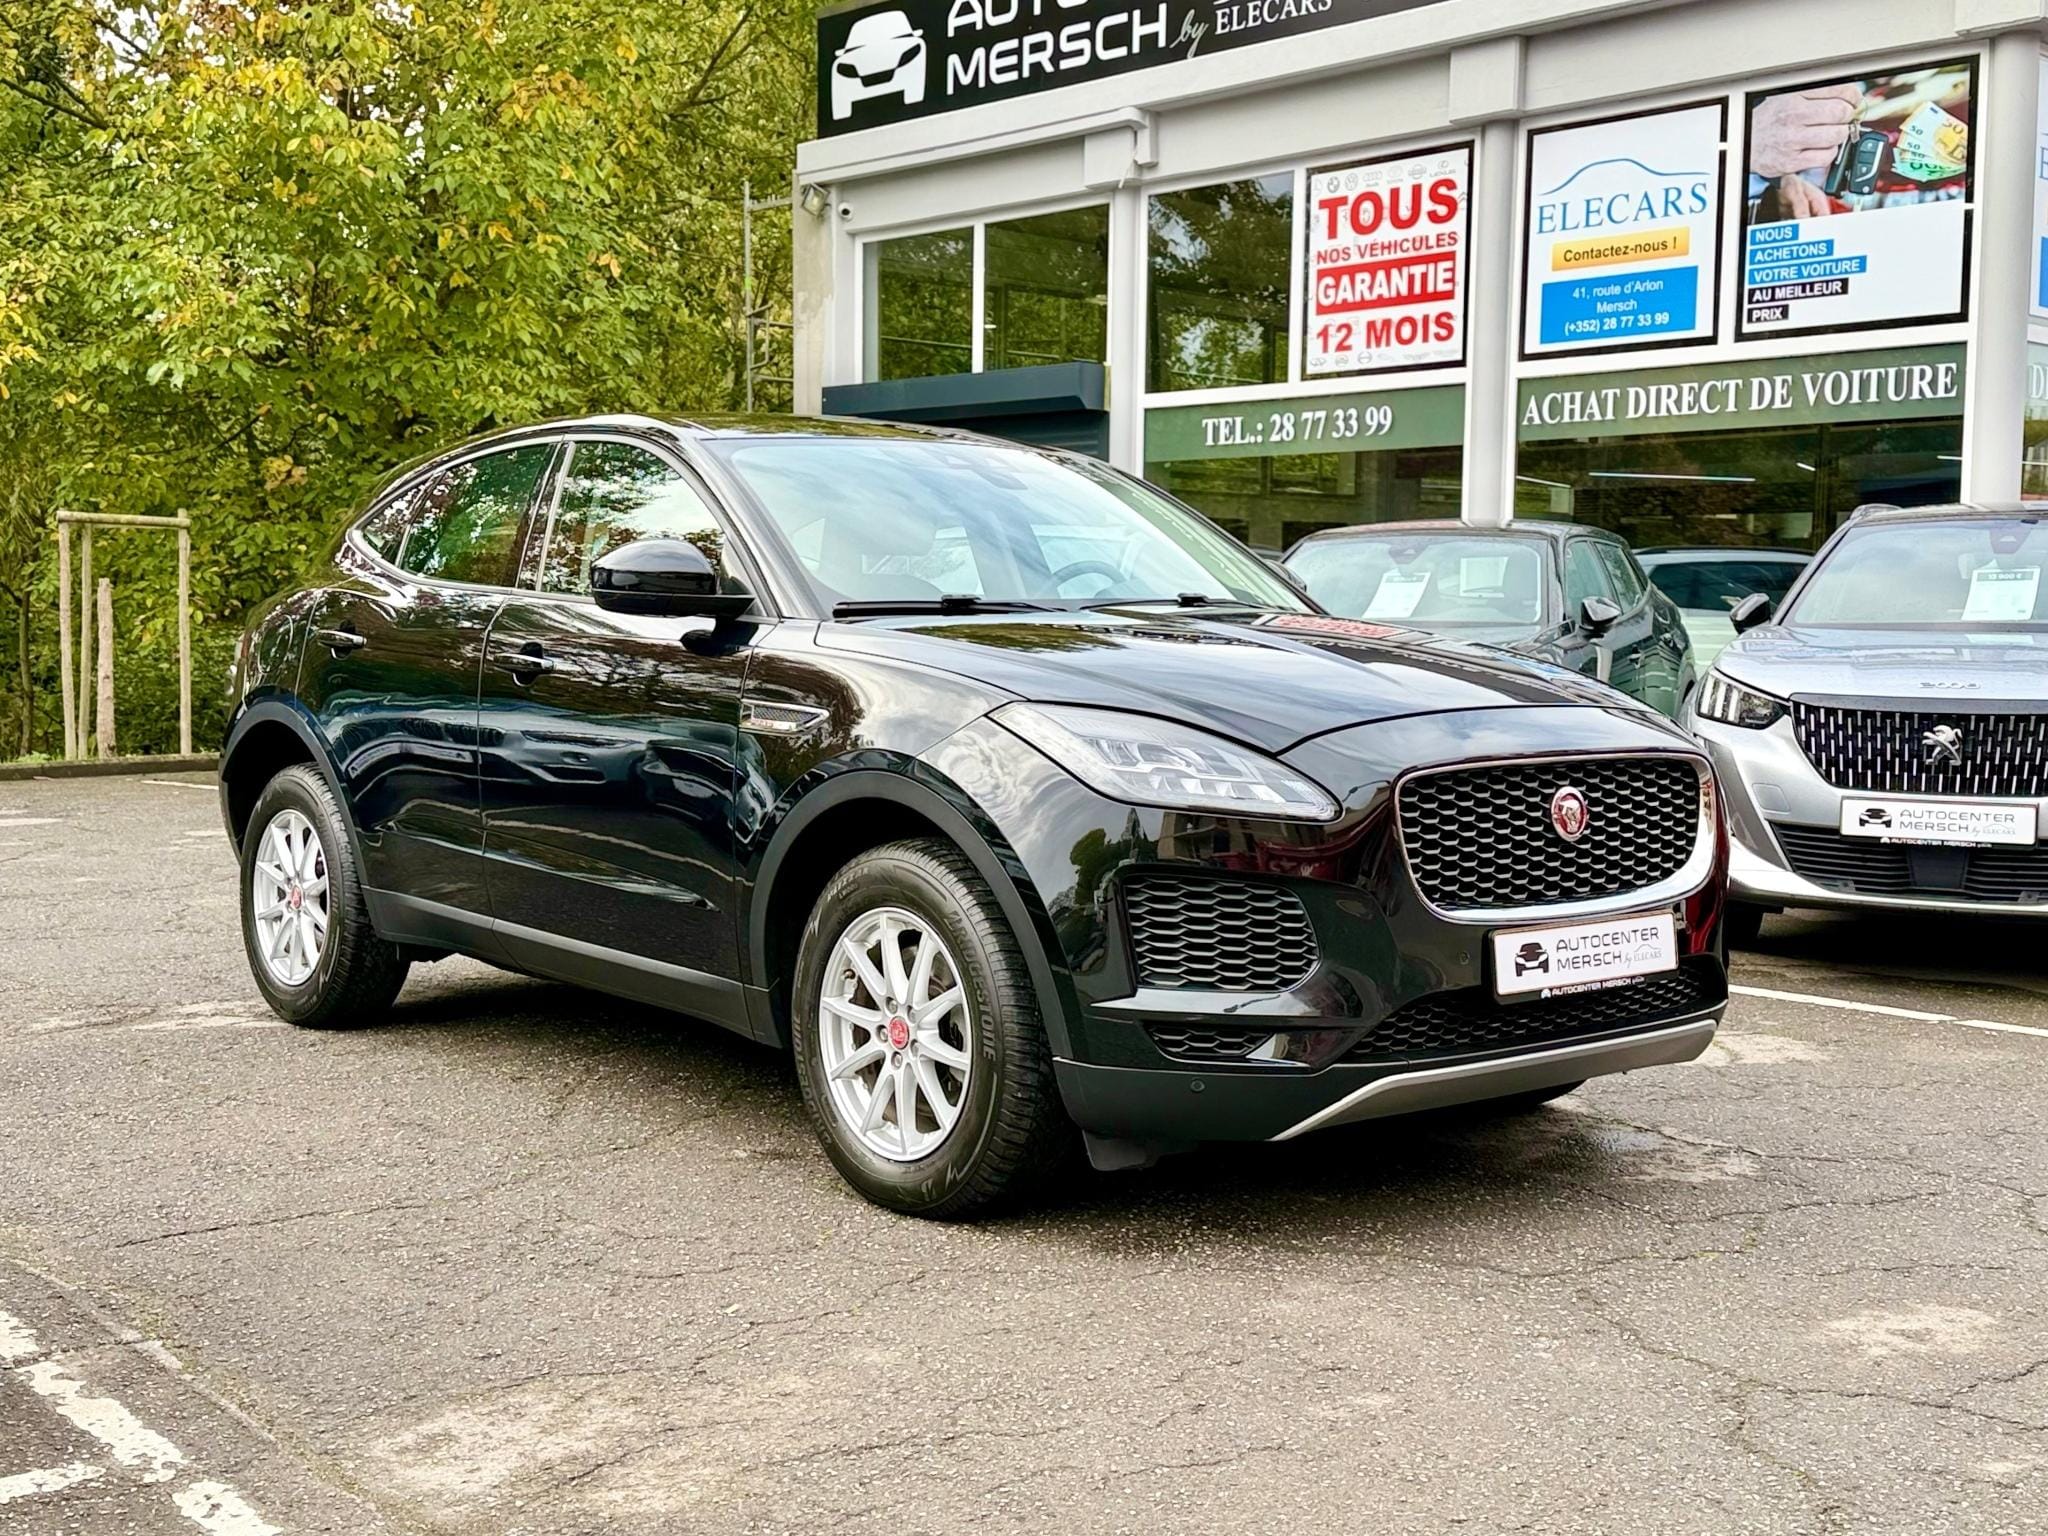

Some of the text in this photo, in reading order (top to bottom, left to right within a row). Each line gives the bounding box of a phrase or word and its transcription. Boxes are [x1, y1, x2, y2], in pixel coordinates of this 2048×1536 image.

[948, 0, 1089, 38] AU
[947, 2, 1167, 95] MERSCH
[1170, 9, 1209, 59] by
[1318, 178, 1459, 240] TOUS
[1536, 183, 1707, 234] ELECARS
[1755, 226, 1792, 242] NOUS
[1316, 231, 1458, 265] NOS VÉHICULES
[1563, 236, 1678, 263] Contactez-nous !
[1754, 243, 1827, 262] ACHETONS
[1754, 259, 1860, 282] VOTRE VOITURE
[1317, 260, 1454, 307] GARANTIE
[1572, 279, 1664, 300] 41, route d'Arlon
[1752, 281, 1842, 302] AU MEILLEUR
[1596, 299, 1637, 313] Mersch
[1752, 307, 1783, 321] PRIX
[1316, 311, 1455, 353] 12 MOIS
[1564, 312, 1669, 336] (+352) 28 77 33 99
[2030, 364, 2048, 400] D
[1522, 363, 1958, 426] ACHAT DIRECT DE VOITURE
[1202, 405, 1393, 446] TEL.: 28 77 33 99
[1899, 821, 1969, 833] MERSCH
[1900, 809, 2015, 824] AUTOCENTER
[1891, 838, 1942, 847] AUTOCENTER
[1943, 840, 1976, 848] MERSCH
[1556, 927, 1660, 953] AUTOCENTER
[1557, 950, 1622, 972] MERSCH
[1552, 982, 1601, 996] AUTOCENTER
[1602, 977, 1632, 989] MERSCH
